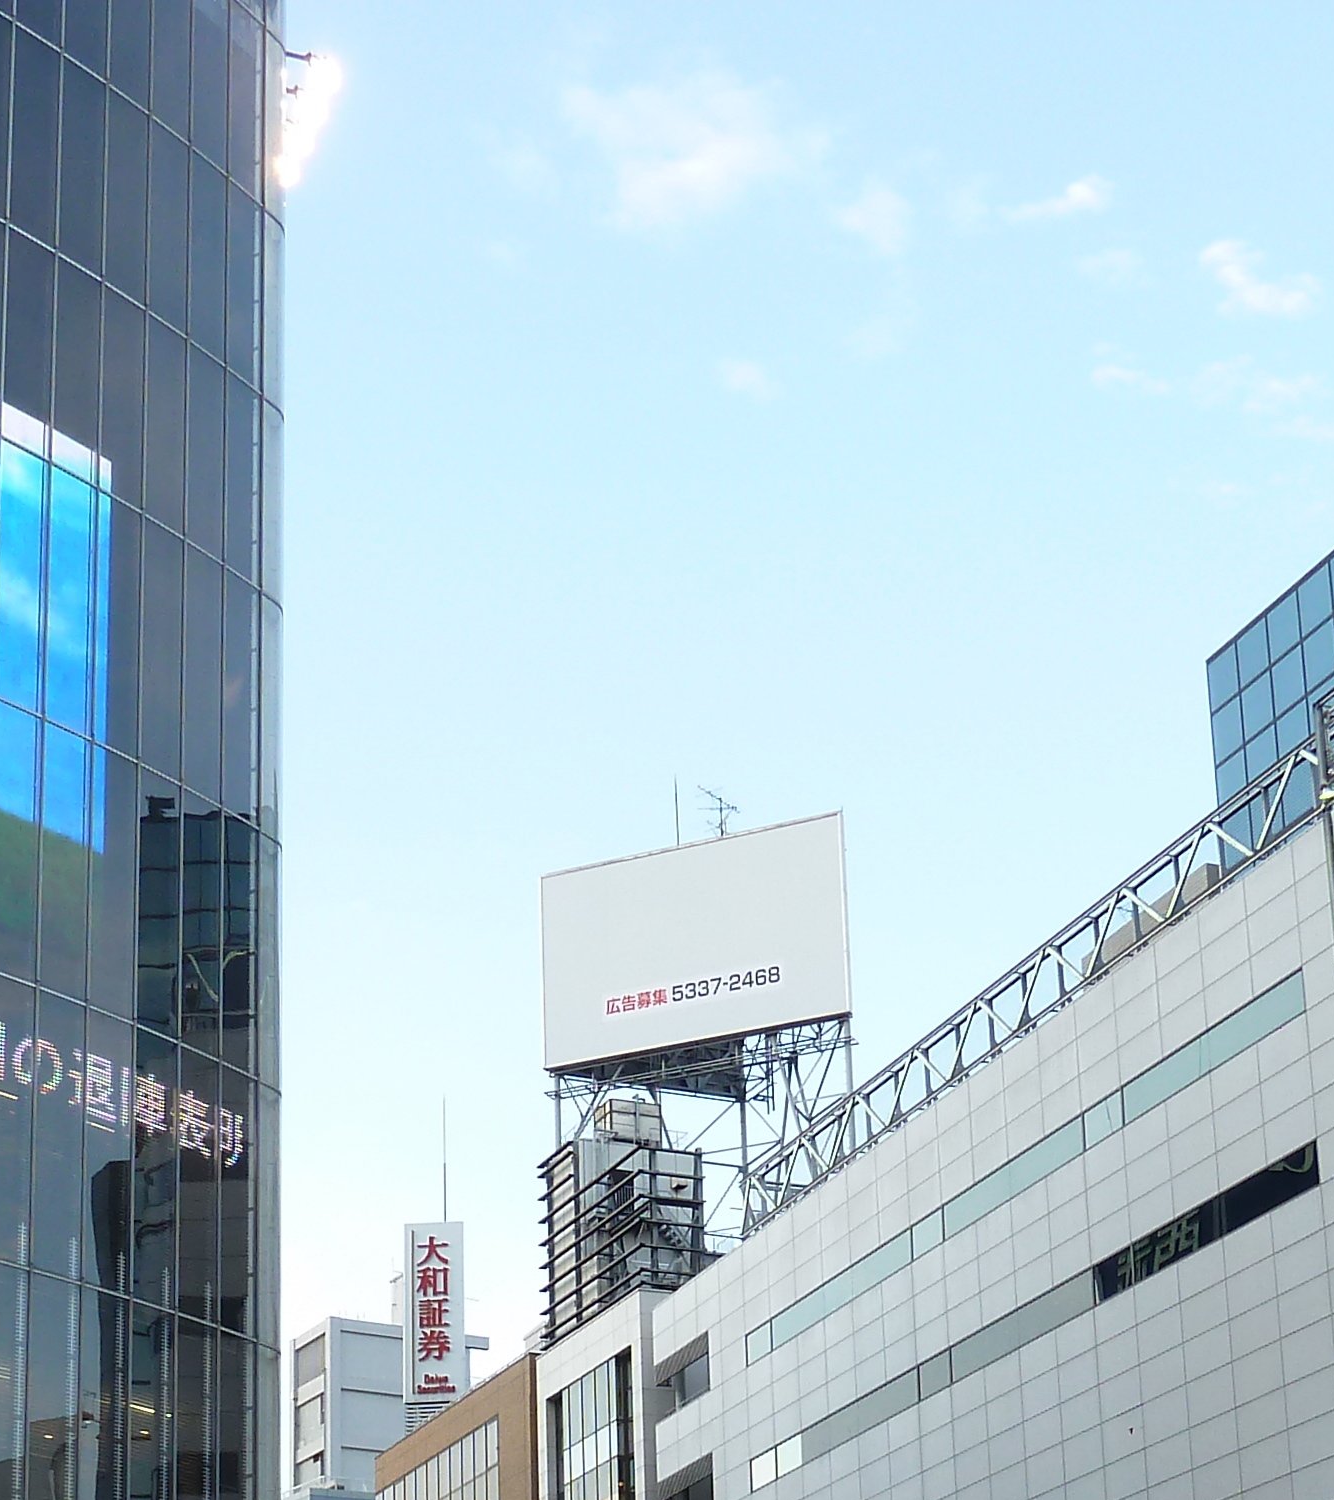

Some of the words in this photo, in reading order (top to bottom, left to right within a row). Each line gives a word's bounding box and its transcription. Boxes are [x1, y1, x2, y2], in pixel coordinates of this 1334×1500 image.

[606, 988, 668, 1015] 広告募集
[672, 966, 781, 1002] 5337-2468
[417, 1236, 450, 1362] 大和証券
